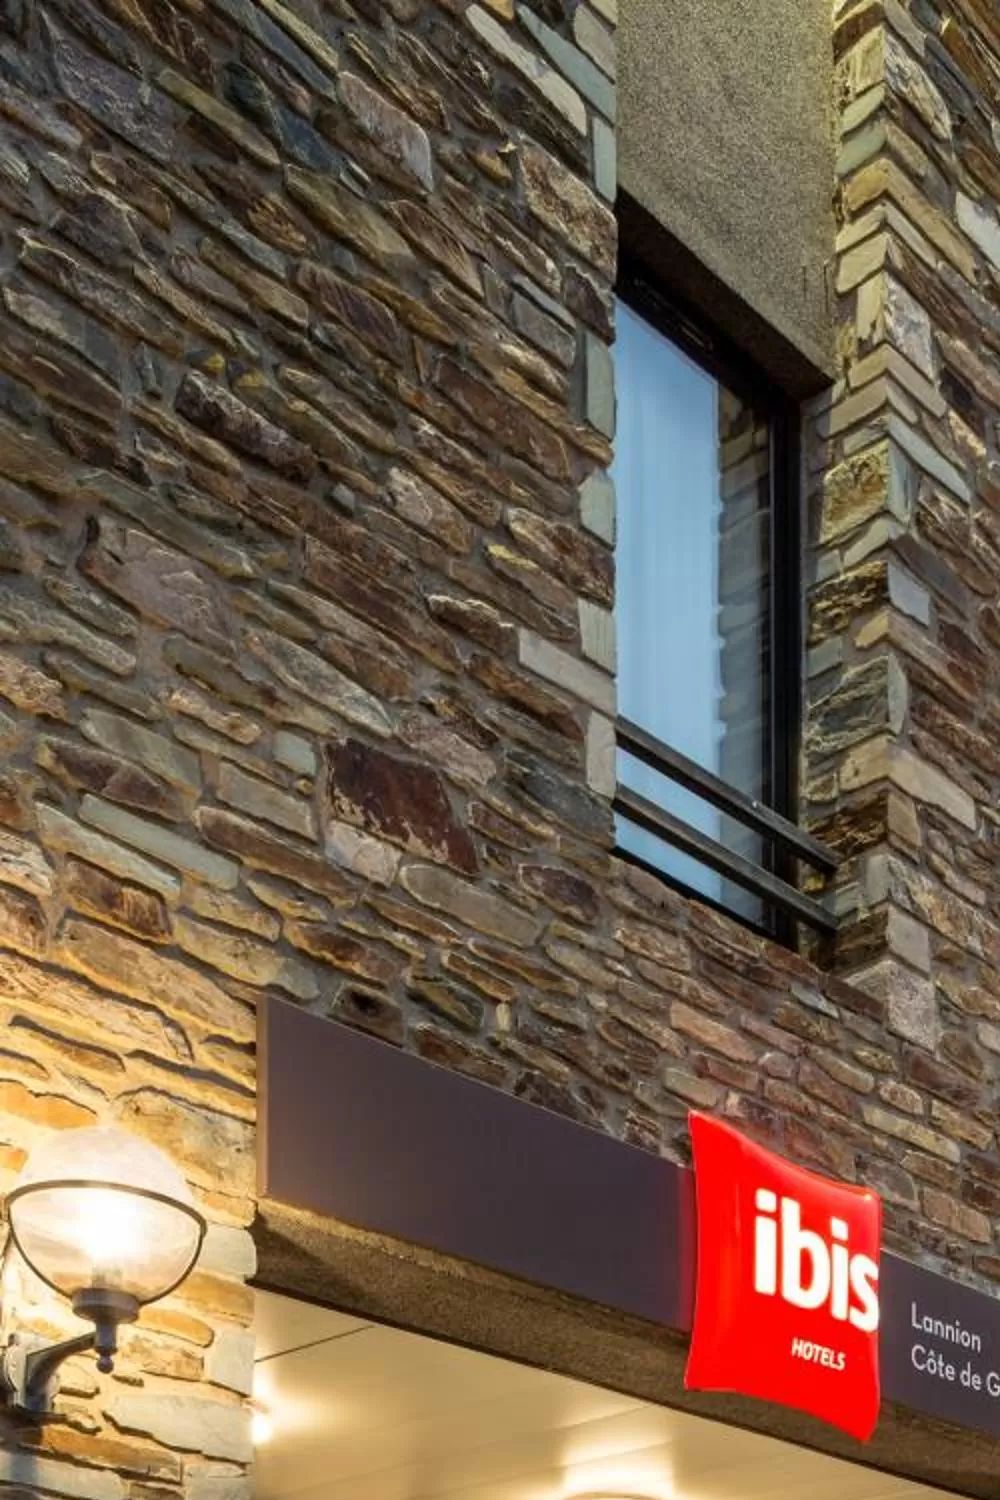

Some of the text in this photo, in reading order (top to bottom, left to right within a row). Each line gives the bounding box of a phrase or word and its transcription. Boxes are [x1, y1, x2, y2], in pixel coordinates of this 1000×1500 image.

[754, 1188, 880, 1333] ibis
[911, 1302, 981, 1352] Lannion
[791, 1337, 846, 1372] HOTELS
[911, 1344, 956, 1381] Côte
[960, 1362, 982, 1391] de
